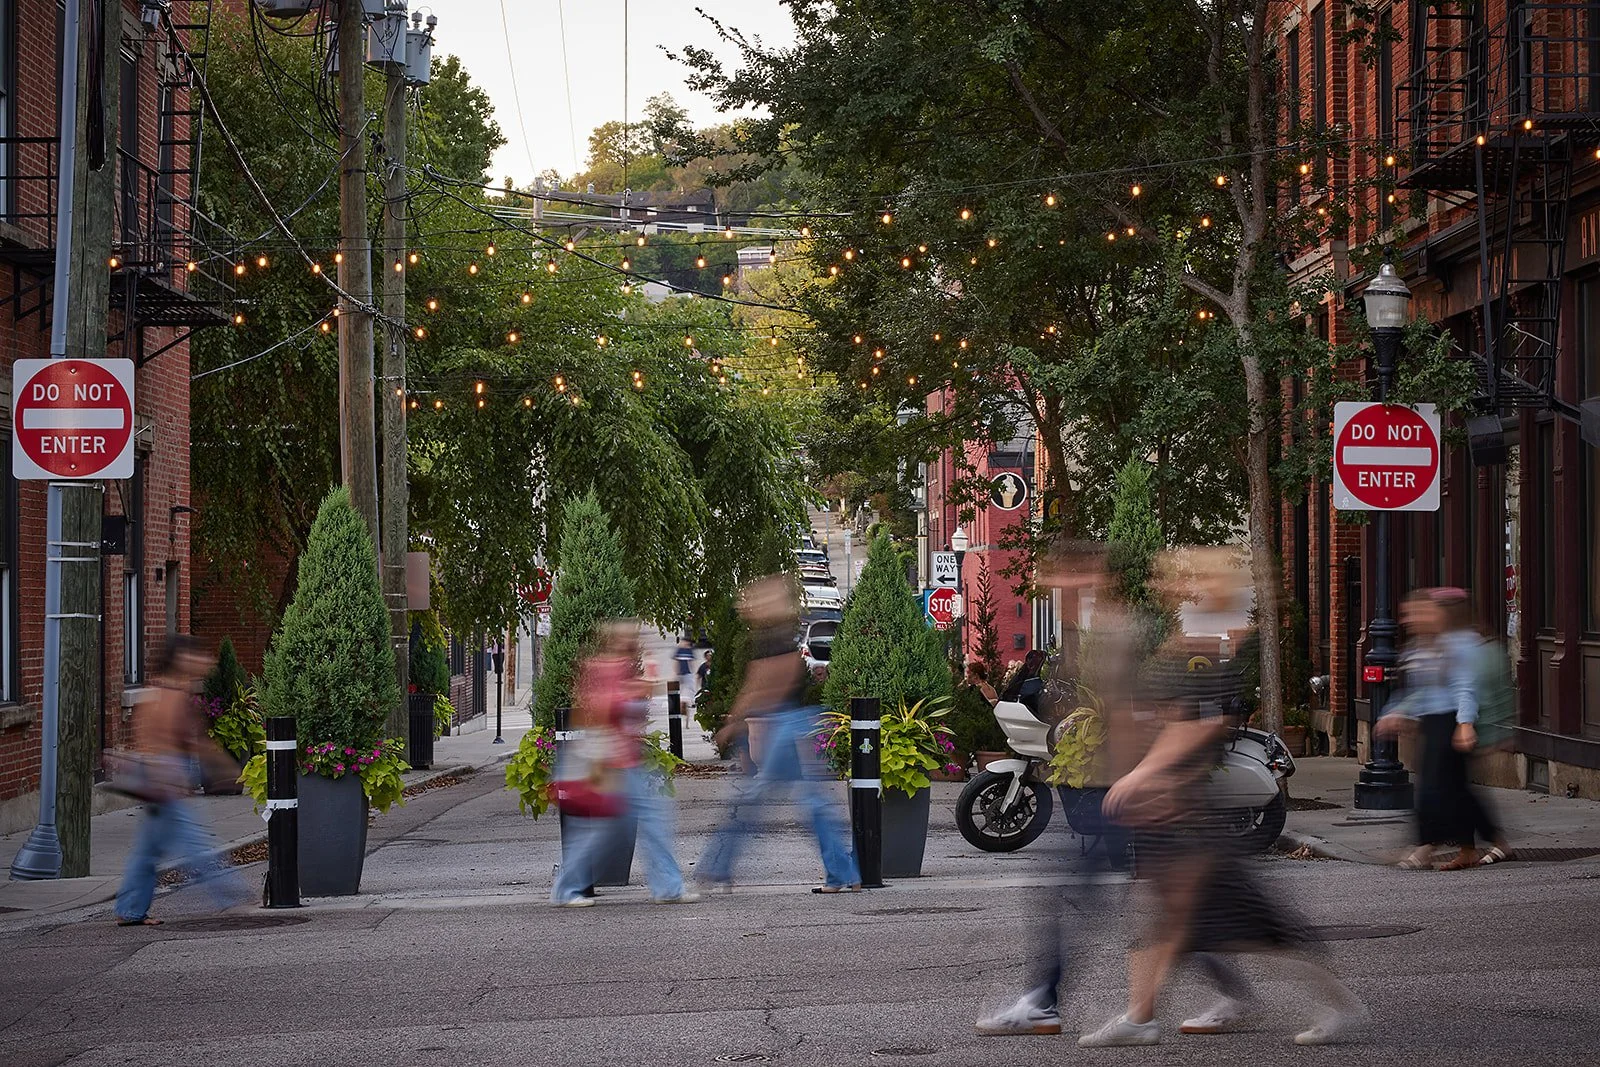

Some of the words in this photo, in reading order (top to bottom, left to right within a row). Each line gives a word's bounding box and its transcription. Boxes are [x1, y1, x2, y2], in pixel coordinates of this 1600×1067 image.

[33, 383, 60, 402] DO
[74, 383, 114, 402] NOT
[1351, 424, 1376, 441] DO
[1388, 424, 1423, 441] NOT
[40, 435, 106, 454] ENTER
[1358, 471, 1416, 488] ENTER
[936, 554, 955, 564] ONE
[936, 564, 956, 573] WAY
[1505, 575, 1515, 591] TOP
[931, 598, 951, 612] STO
